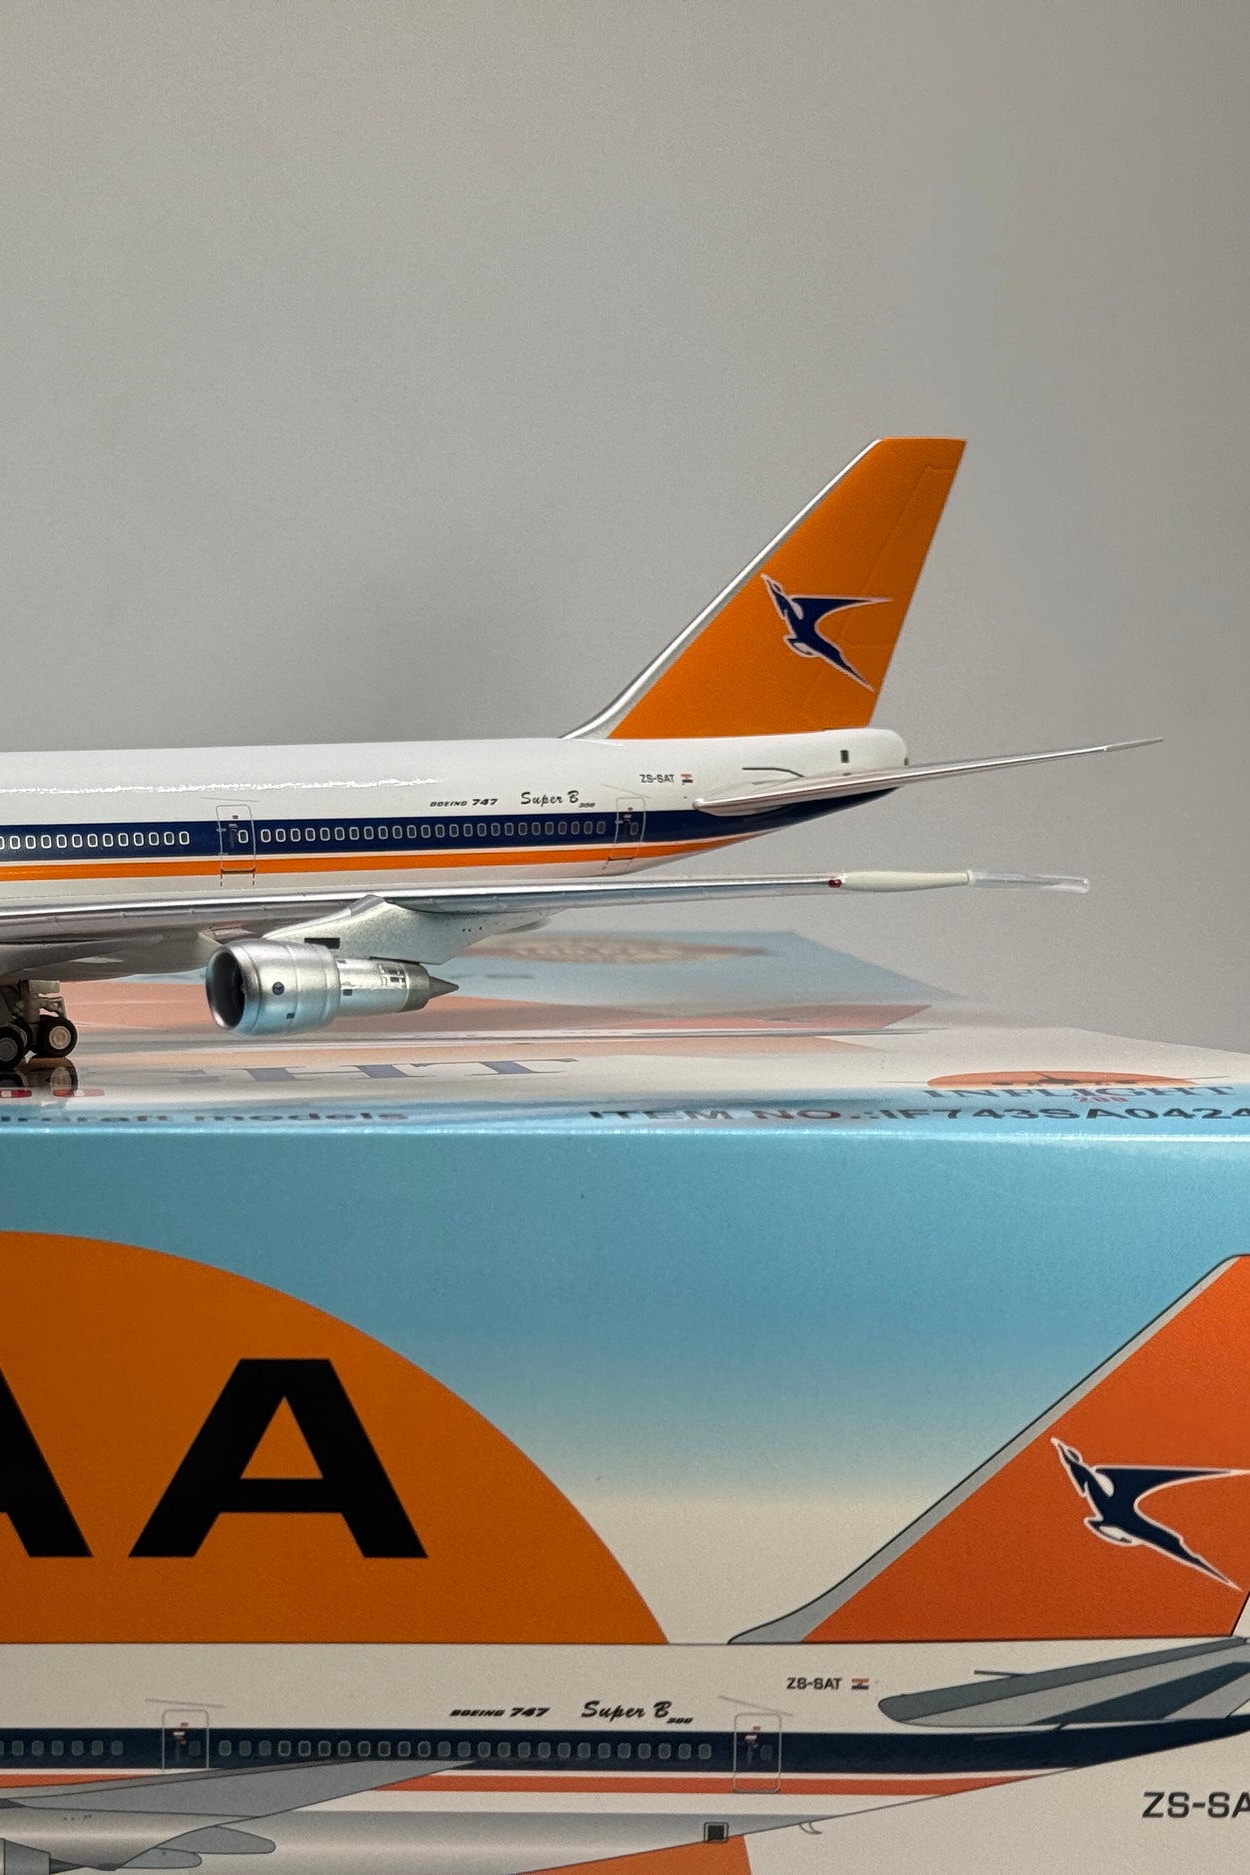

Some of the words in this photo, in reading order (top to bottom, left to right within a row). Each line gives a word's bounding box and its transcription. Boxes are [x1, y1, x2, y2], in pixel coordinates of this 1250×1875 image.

[640, 773, 675, 784] ZS-SAT
[472, 798, 499, 806] 747
[520, 791, 563, 808] Super
[568, 790, 579, 803] B
[922, 1086, 1235, 1098] INFLIGHT
[588, 1110, 733, 1120] ITEM
[450, 1709, 506, 1717] BOEING
[510, 1708, 551, 1718] 747
[580, 1700, 646, 1722] Super
[653, 1700, 671, 1717] B
[1141, 1791, 1250, 1818] ZS-SA
